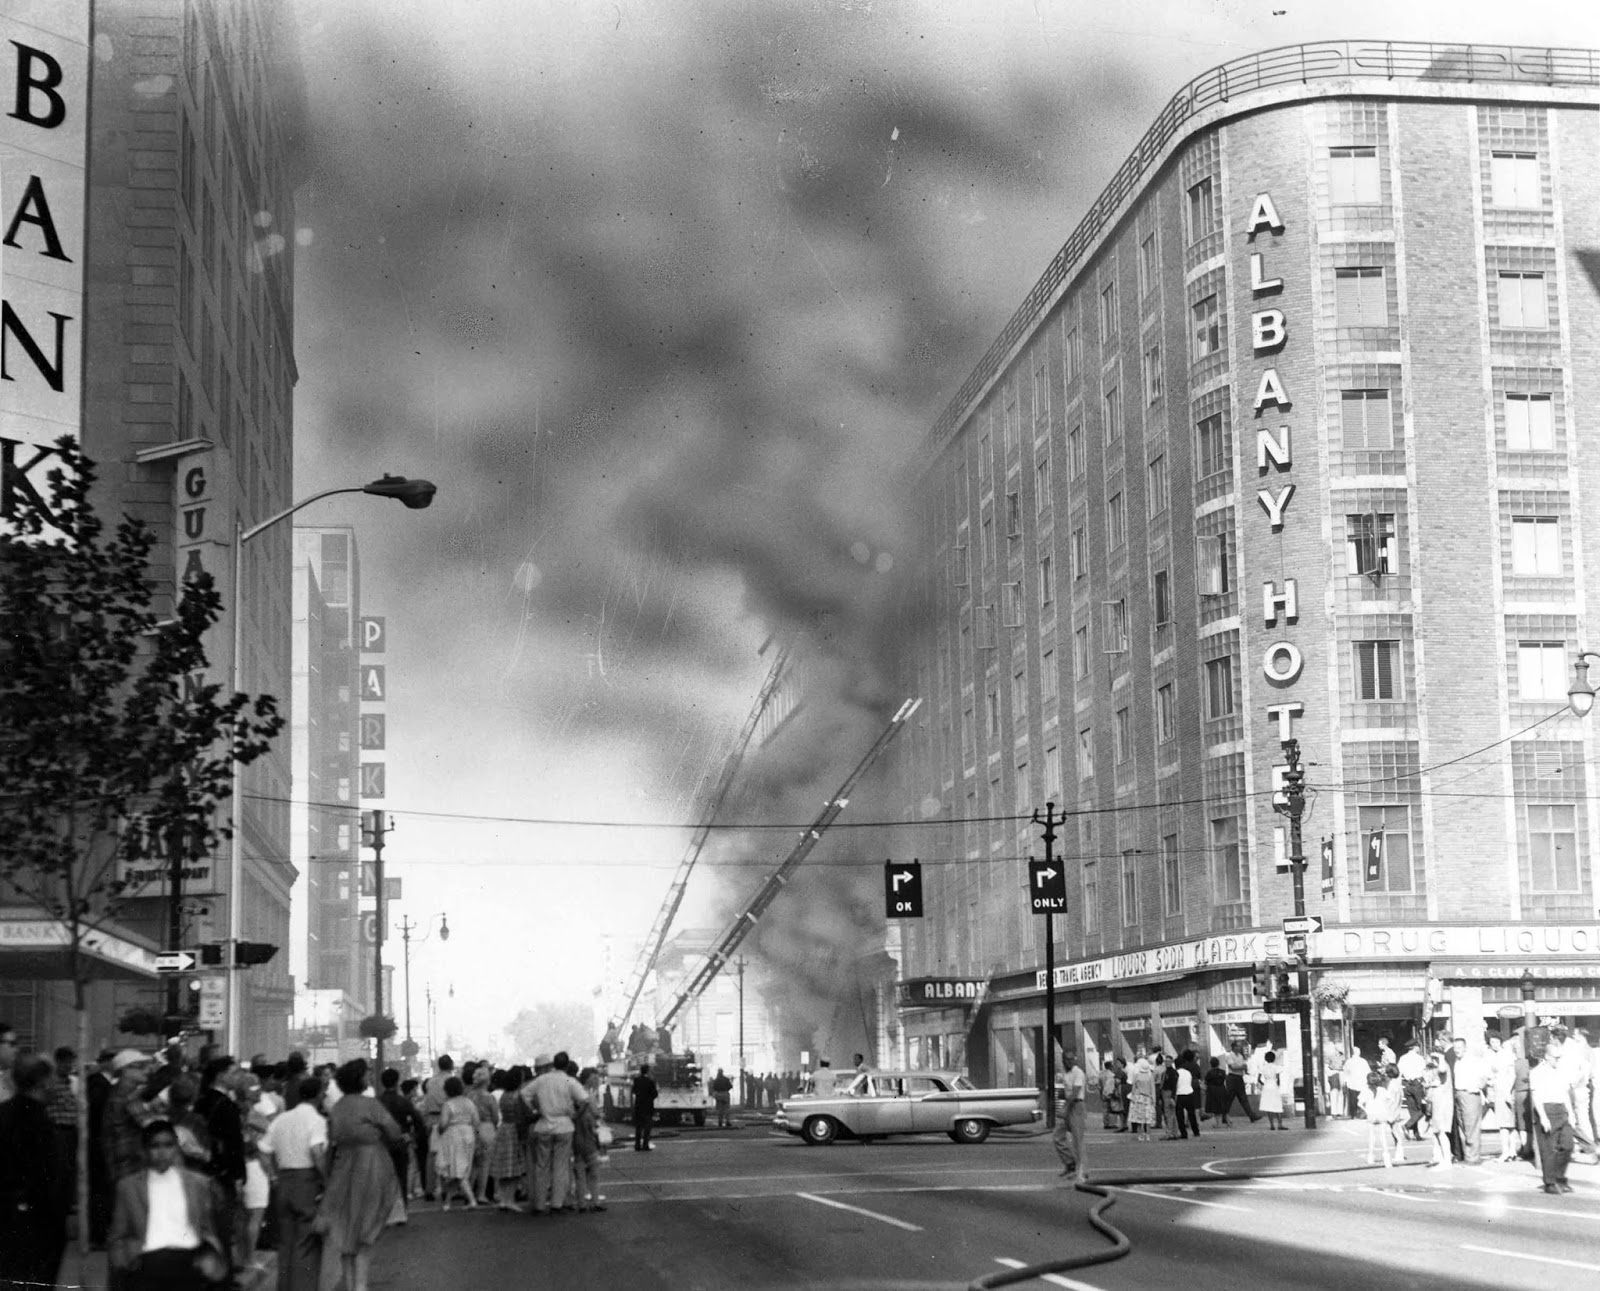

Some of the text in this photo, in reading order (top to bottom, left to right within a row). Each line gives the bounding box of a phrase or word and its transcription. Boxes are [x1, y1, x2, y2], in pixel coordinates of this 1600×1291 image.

[1246, 192, 1297, 529] ALBANY
[1263, 578, 1307, 871] HOTEL
[896, 902, 912, 911] OK
[1034, 898, 1064, 908] ONLY
[1112, 928, 1600, 978] LIQUOR SODA CLARKE DRUG LIQUO
[1059, 967, 1079, 983] TRAVEL
[1080, 963, 1102, 981] AGENCY
[1547, 967, 1583, 977] DRUG
[924, 982, 985, 998] ALBANY
